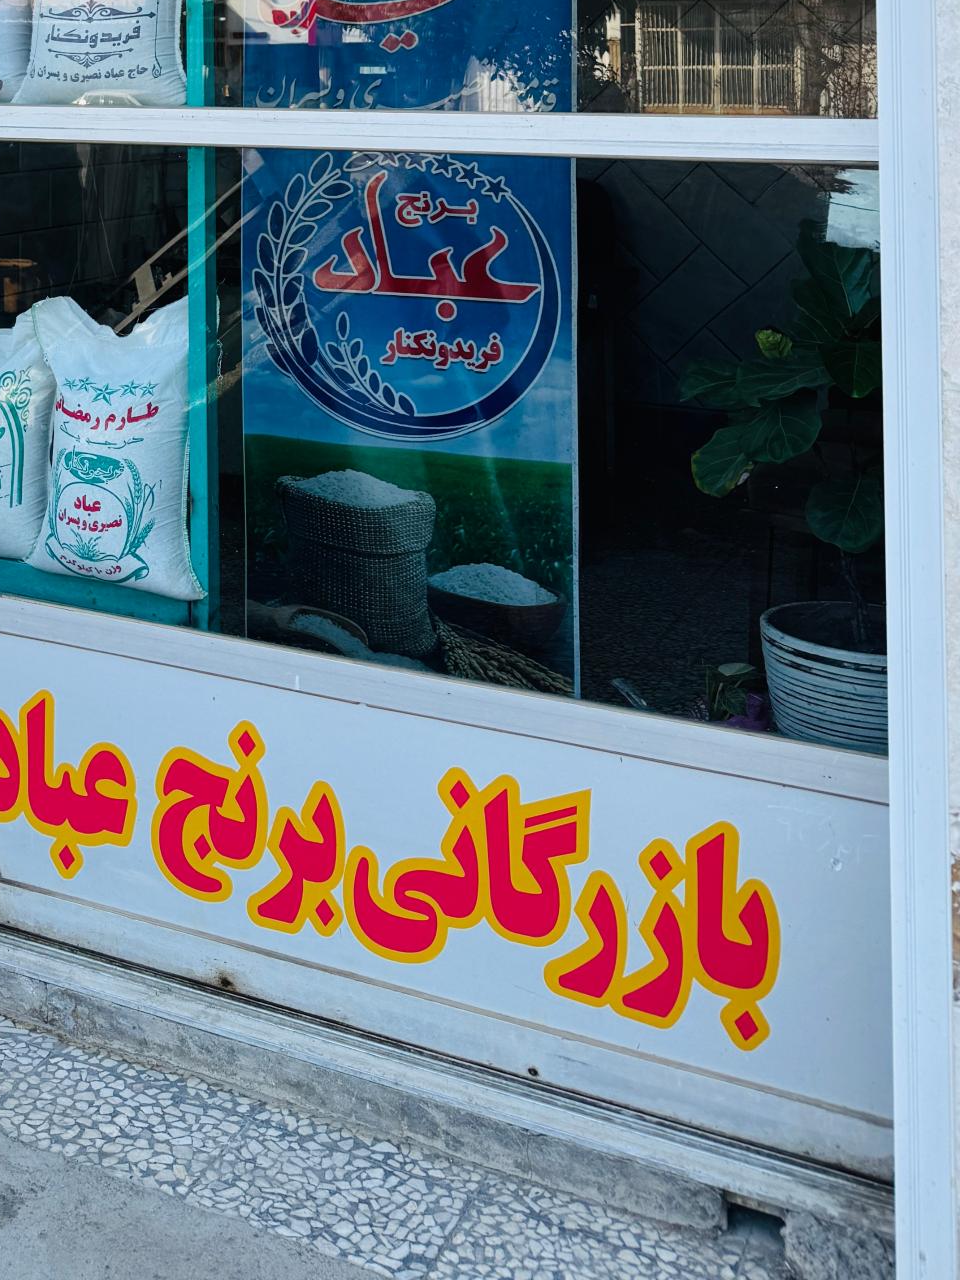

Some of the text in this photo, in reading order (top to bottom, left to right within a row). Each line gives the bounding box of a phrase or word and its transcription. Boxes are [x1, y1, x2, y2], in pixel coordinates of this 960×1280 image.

[45, 20, 142, 48] فریدونکنار
[395, 190, 479, 226] برنج
[313, 170, 542, 321] عباد
[379, 327, 503, 373] فریدونکنار
[103, 401, 160, 431] طارم
[73, 494, 102, 517] عباد
[89, 514, 123, 533] نصیری
[155, 727, 344, 931] برنج
[347, 775, 773, 1043] بازرگانی
